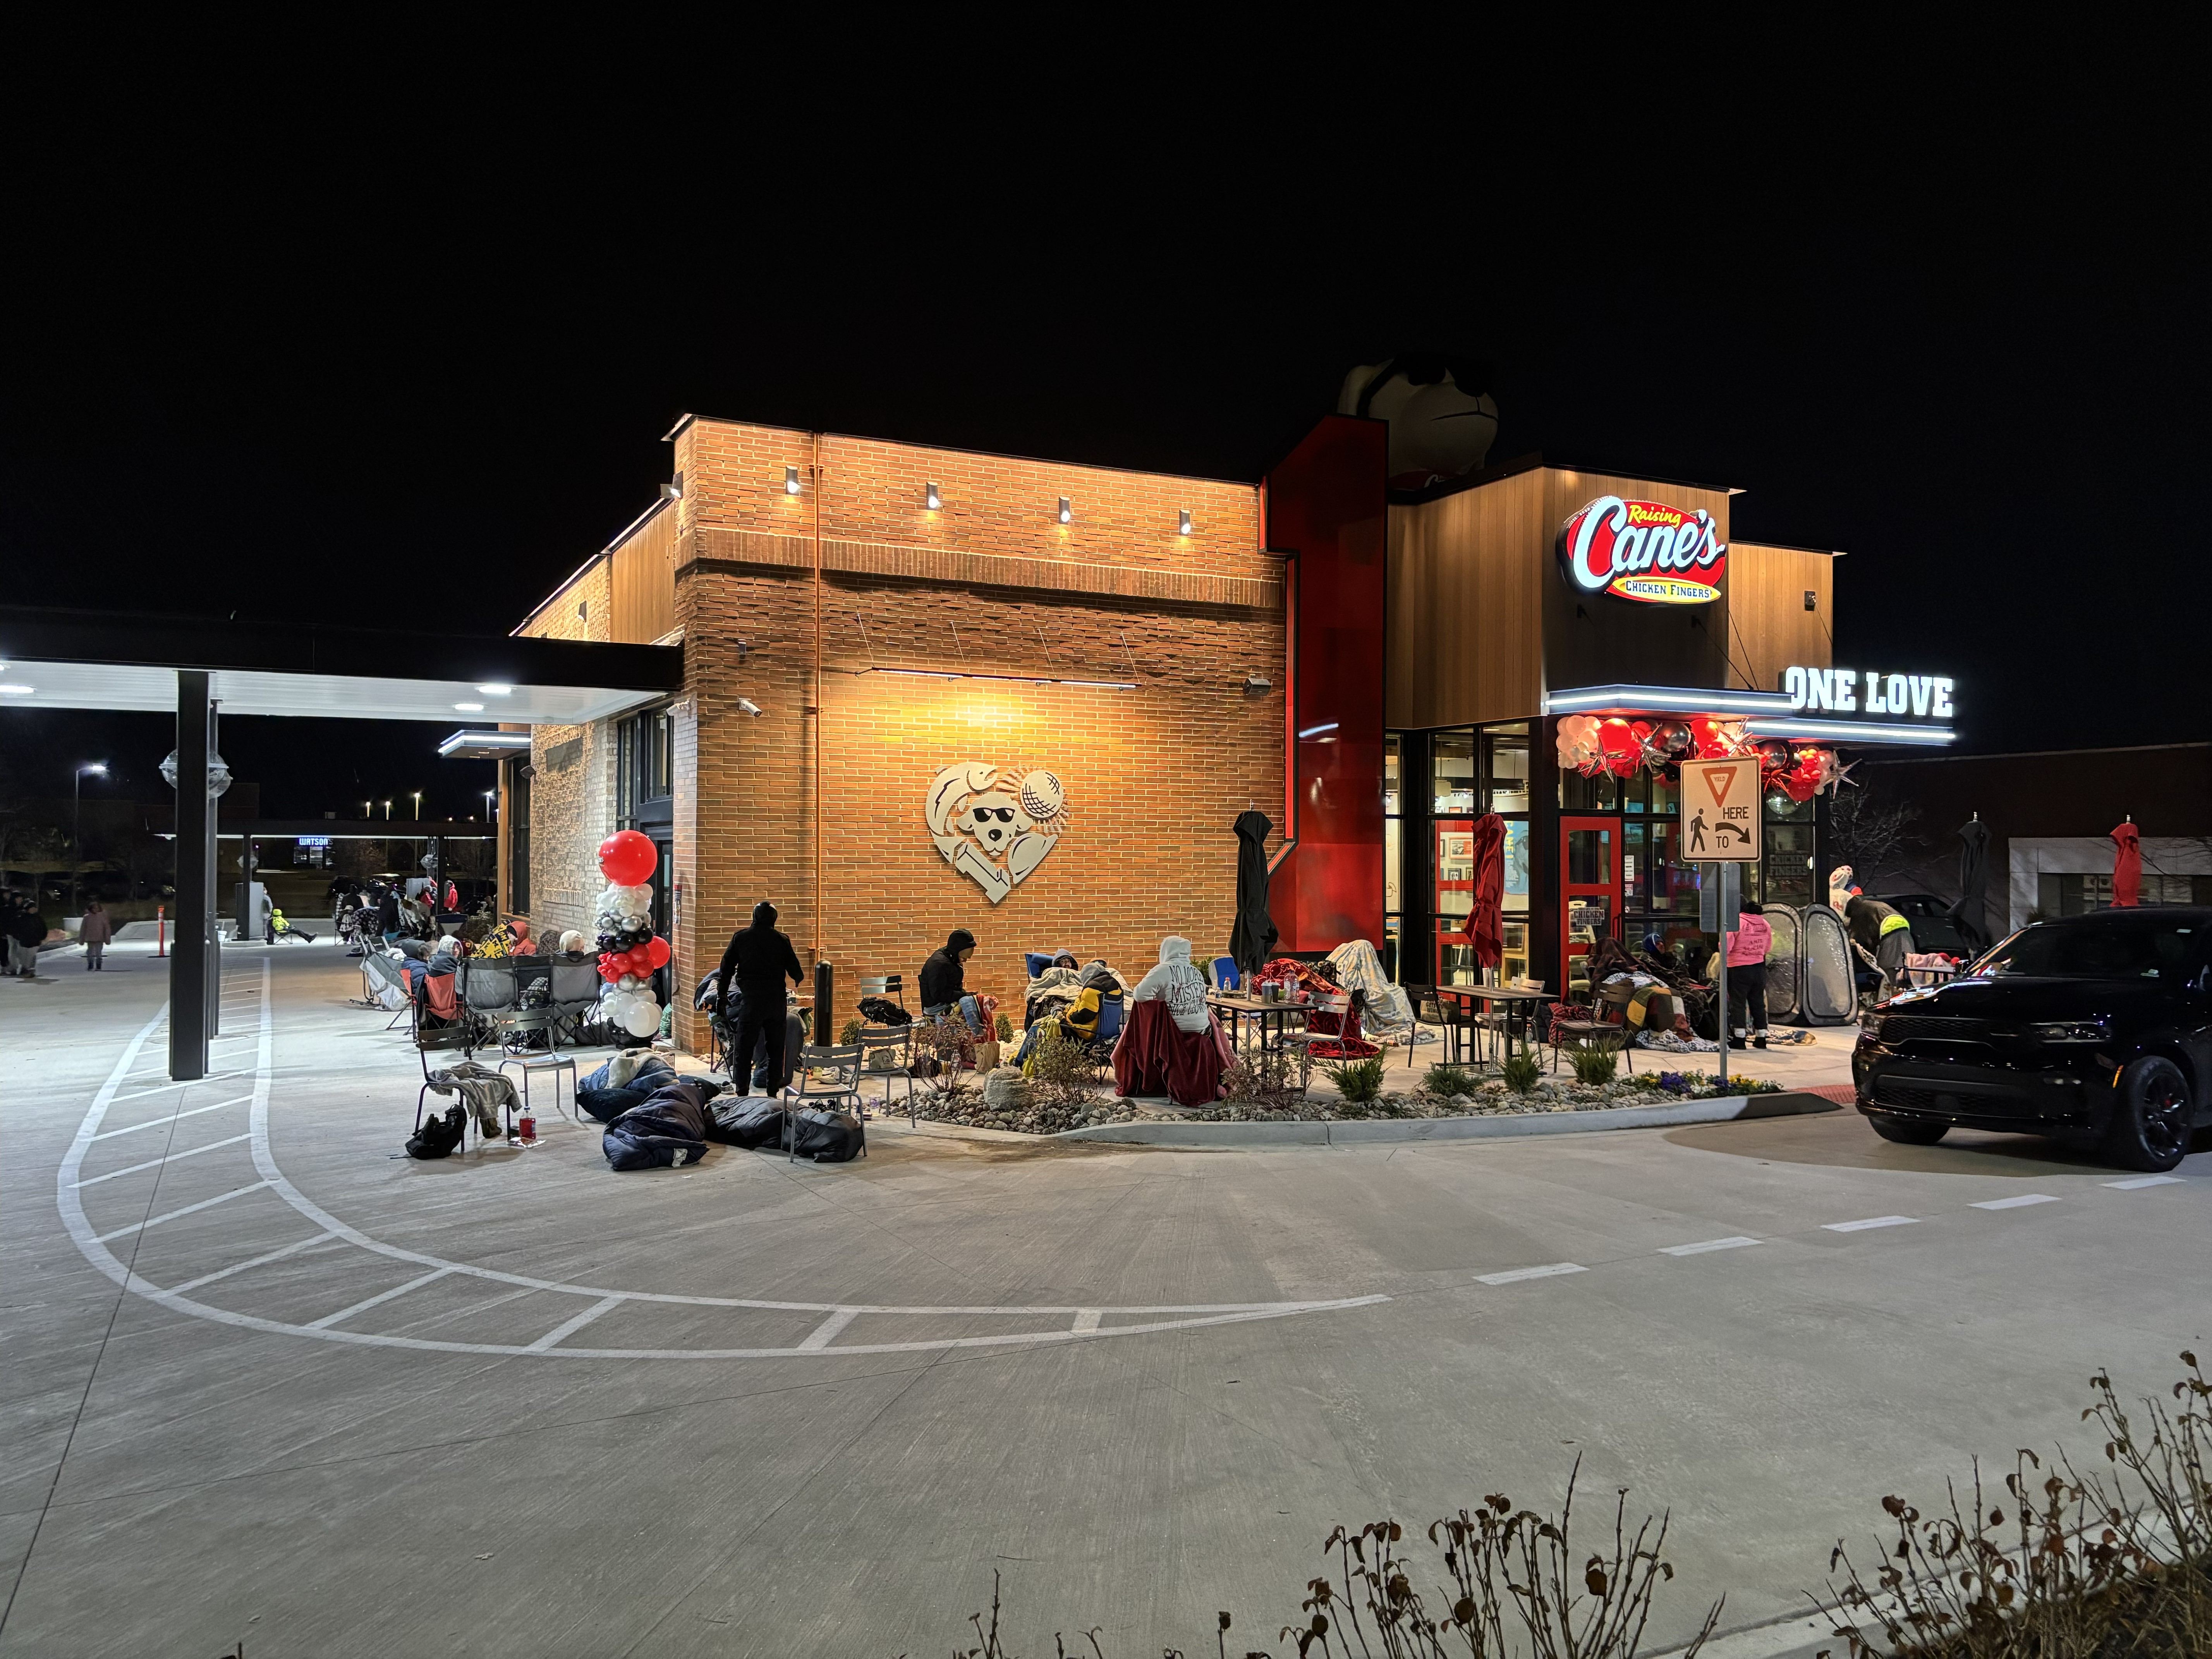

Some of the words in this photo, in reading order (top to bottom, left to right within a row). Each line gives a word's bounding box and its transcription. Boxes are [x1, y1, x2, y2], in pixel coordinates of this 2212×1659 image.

[1628, 505, 1681, 528] Raising
[1573, 496, 1726, 588] Cane's
[1786, 666, 1856, 711] ONE
[1865, 672, 1953, 717] LOVE
[1723, 806, 1749, 819] HERE
[1716, 836, 1729, 848] TO
[1169, 965, 1182, 986] NO
[1183, 966, 1204, 984] MORE
[1169, 982, 1205, 1003] MISTER
